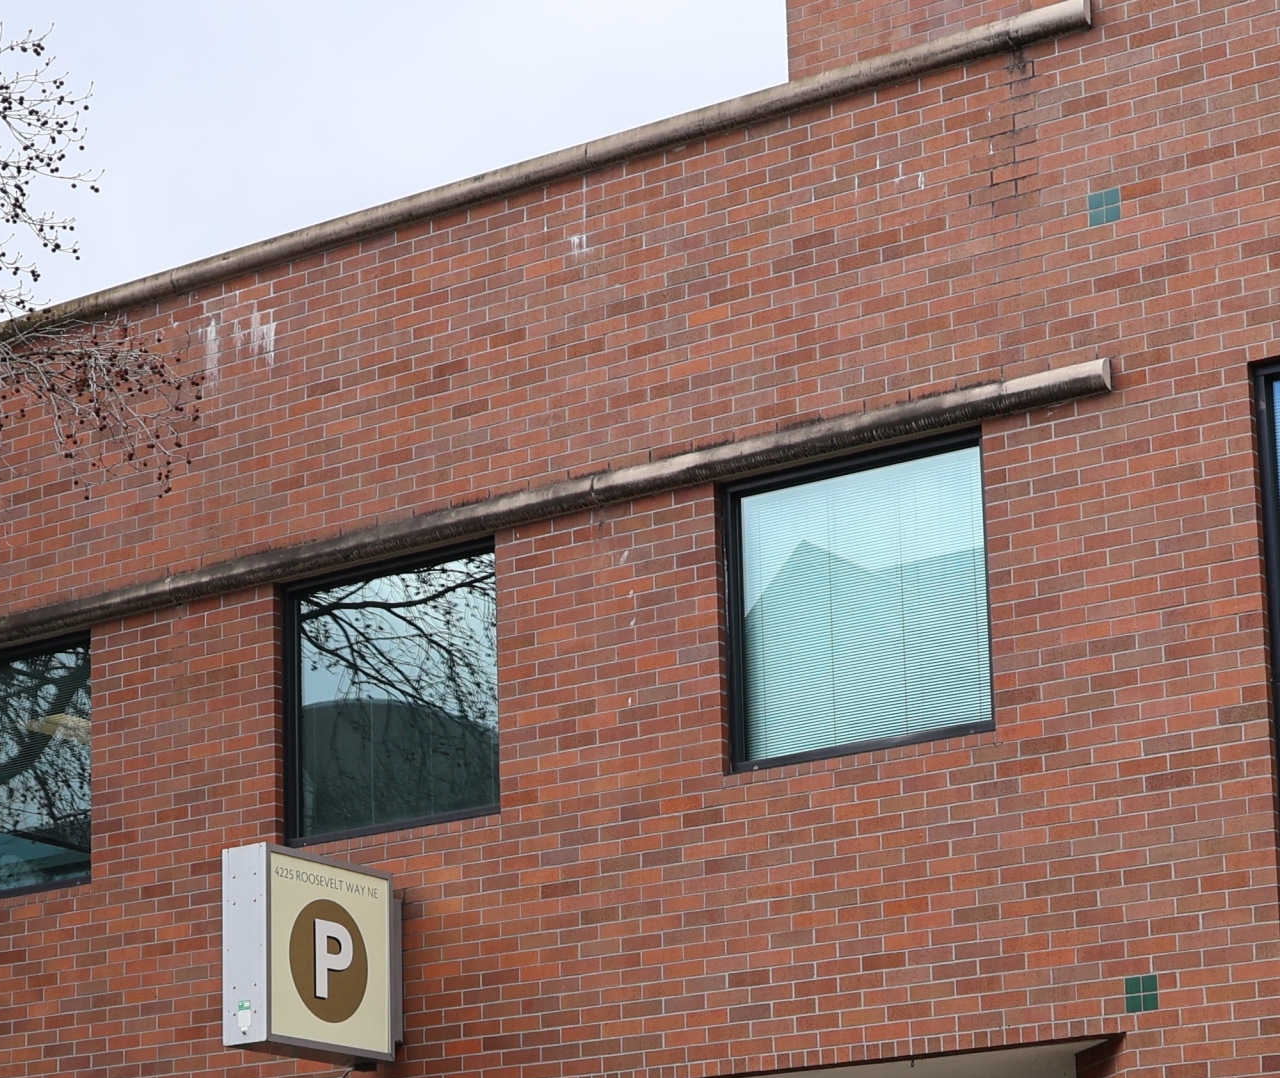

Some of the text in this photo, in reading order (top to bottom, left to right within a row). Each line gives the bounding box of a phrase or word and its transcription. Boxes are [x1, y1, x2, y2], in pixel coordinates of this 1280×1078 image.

[274, 866, 378, 899] 4225 ROOSEVELT WAY NE
[314, 918, 354, 999] P
